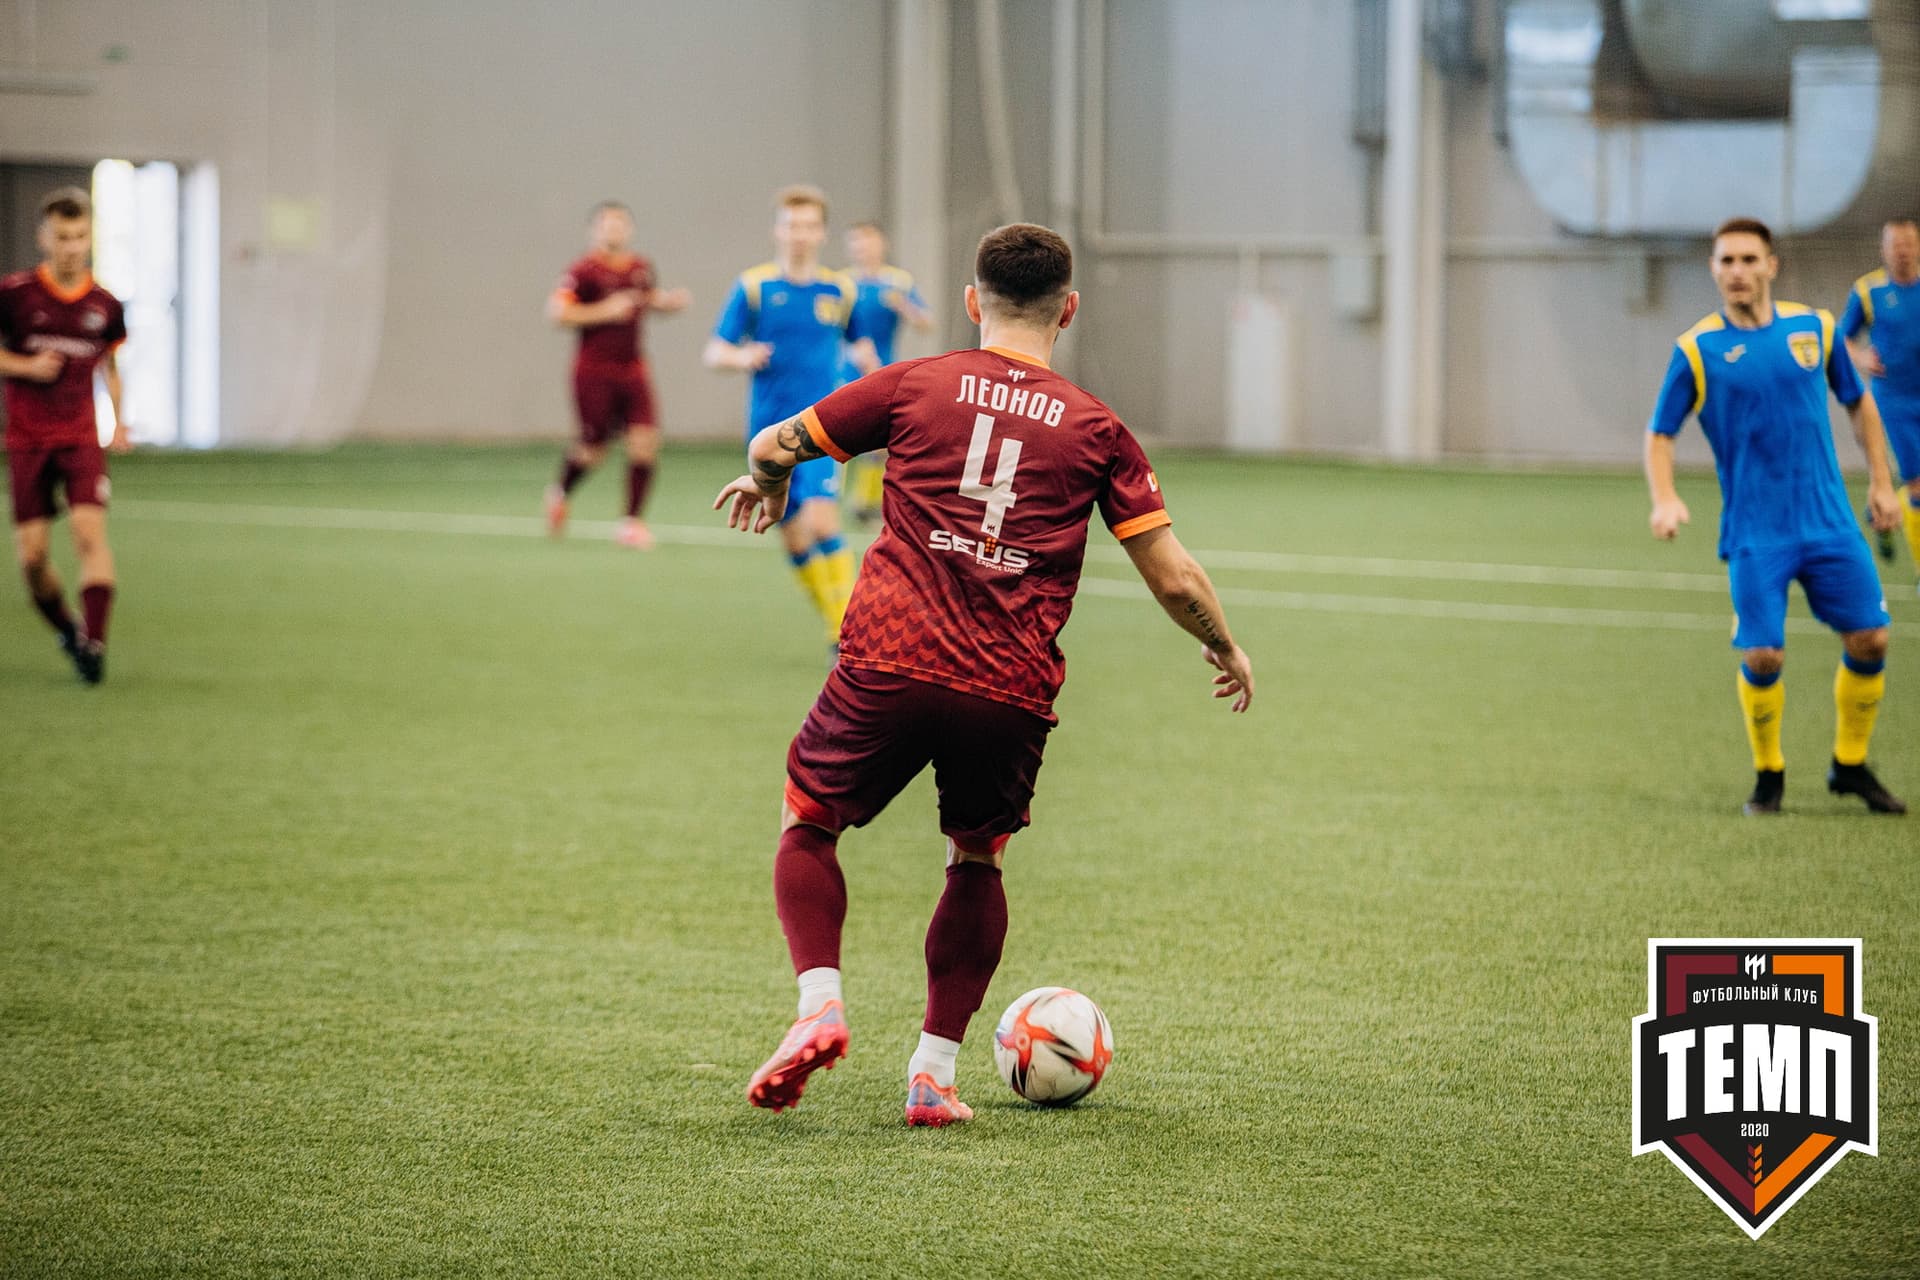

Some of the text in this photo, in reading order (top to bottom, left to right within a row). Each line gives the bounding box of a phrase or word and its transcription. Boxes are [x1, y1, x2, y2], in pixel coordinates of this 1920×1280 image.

[956, 374, 1065, 427] ЛЕОНОВ
[958, 412, 1023, 538] 4
[928, 529, 1029, 568] SEUS
[976, 559, 1024, 576] Export Unio
